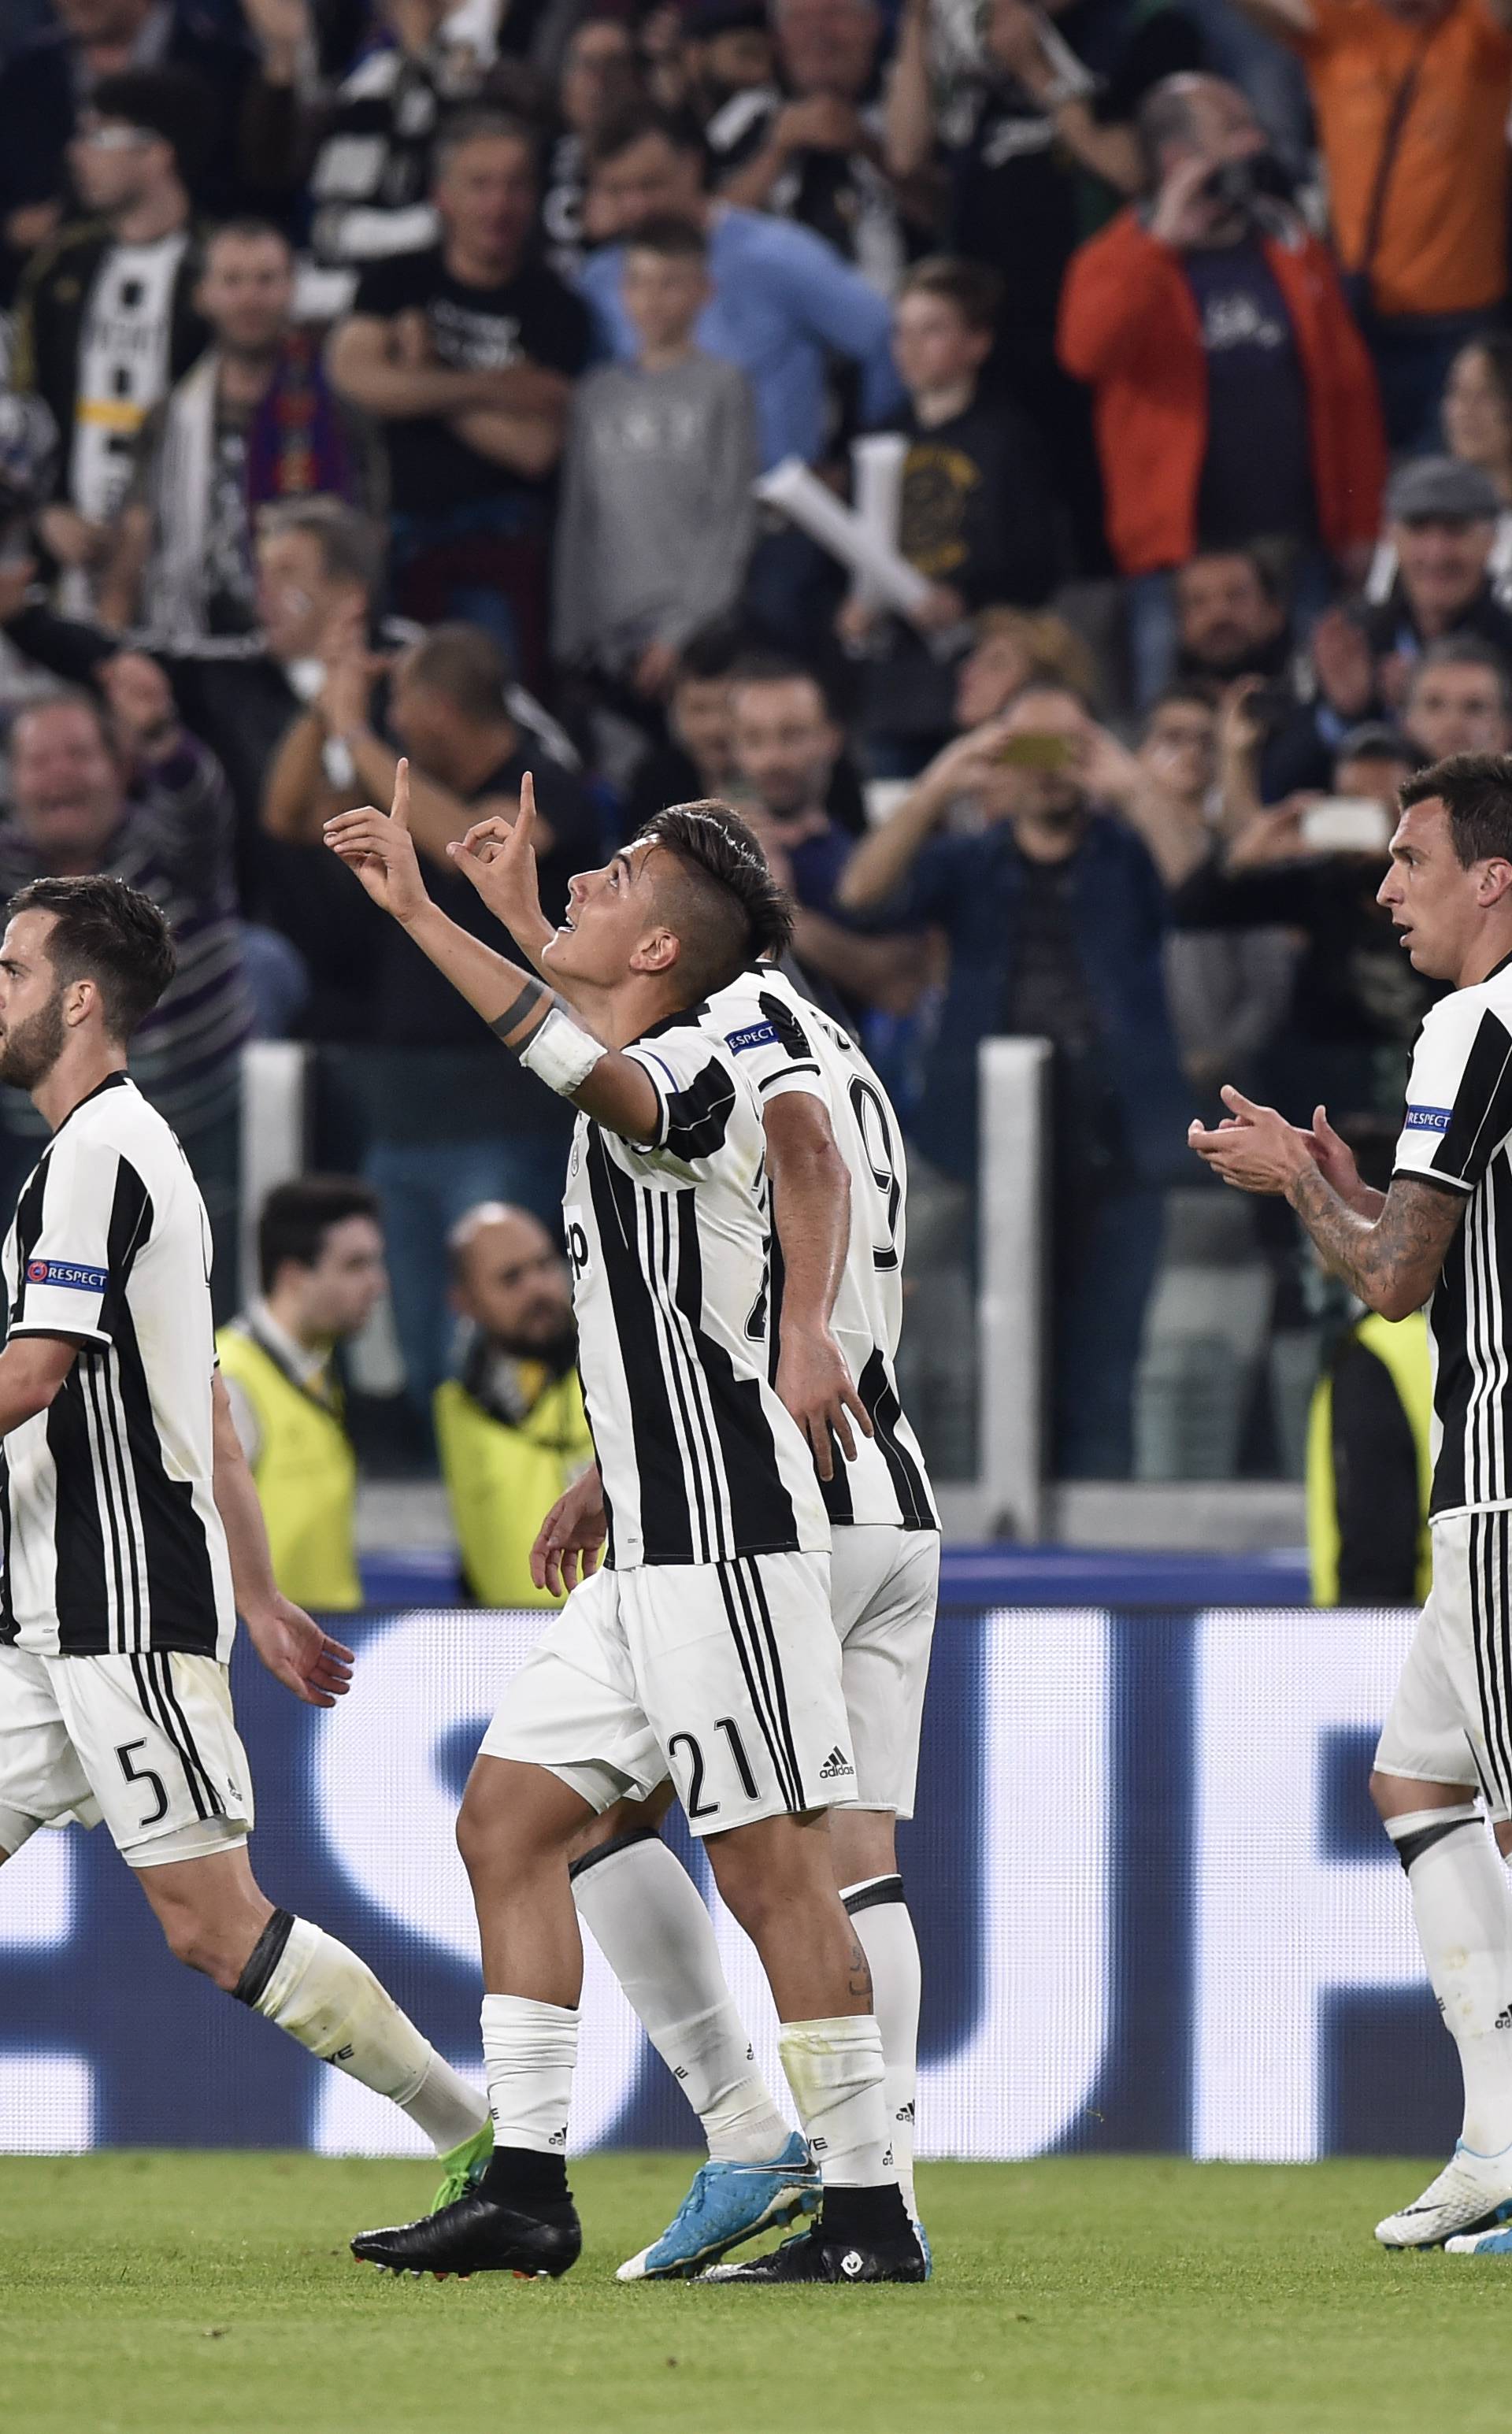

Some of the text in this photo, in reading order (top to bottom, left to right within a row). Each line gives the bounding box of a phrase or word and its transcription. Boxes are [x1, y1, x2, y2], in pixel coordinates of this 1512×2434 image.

[1408, 1112, 1451, 1128] RESPECT
[847, 1073, 899, 1273] 9
[48, 1267, 107, 1287] RESPECT
[113, 1737, 171, 1828] 5
[667, 1716, 762, 1821] 21
[819, 1764, 854, 1779] adidas
